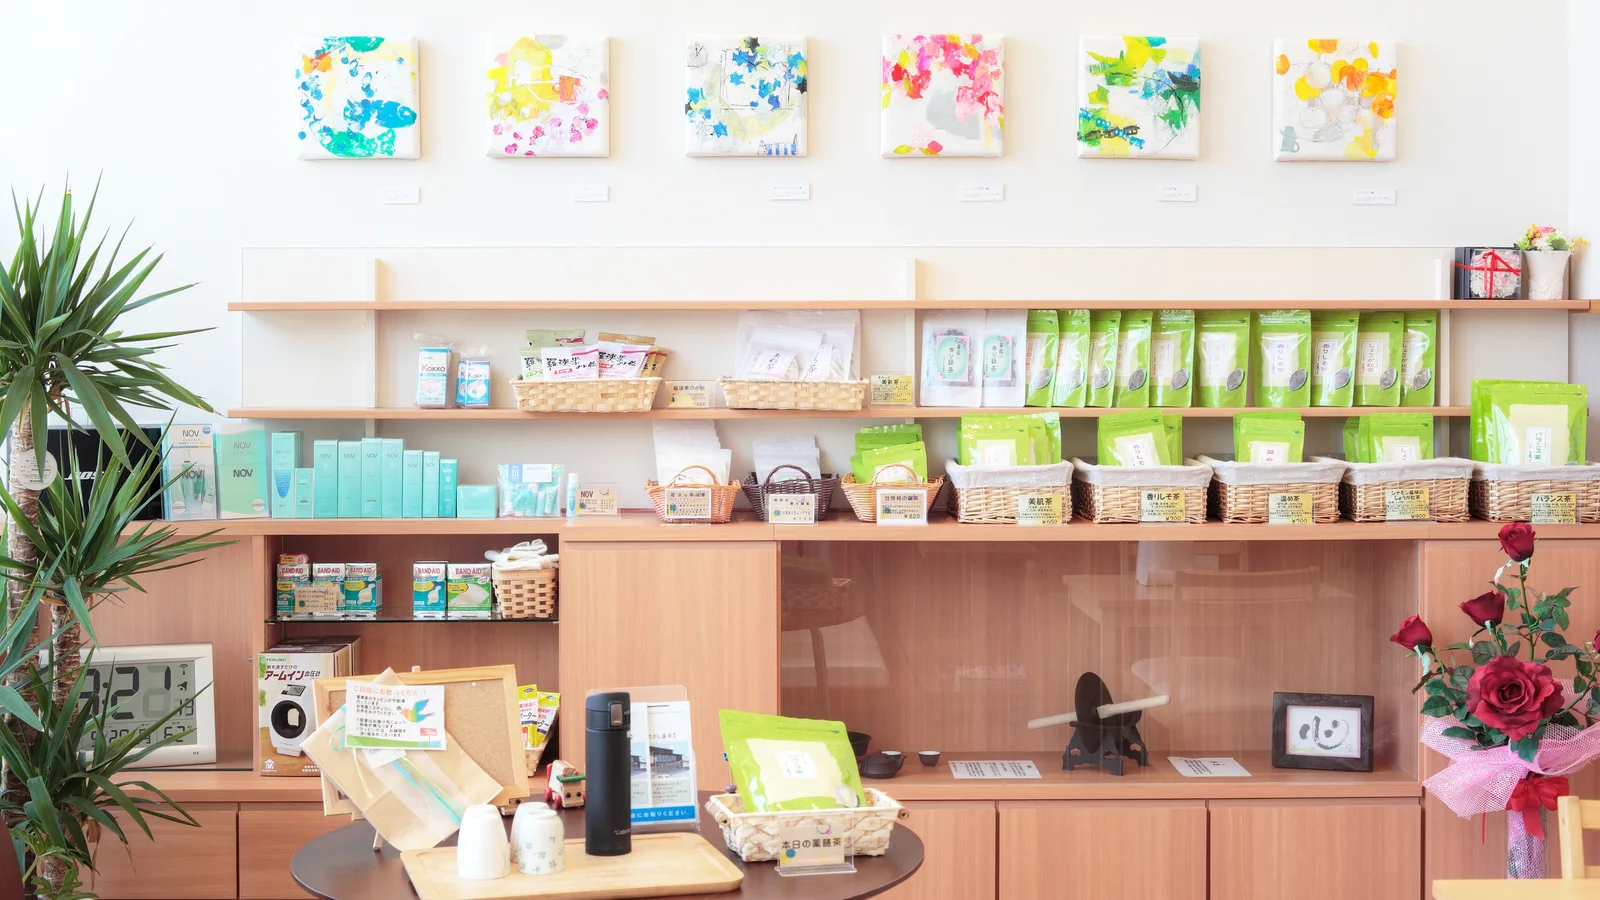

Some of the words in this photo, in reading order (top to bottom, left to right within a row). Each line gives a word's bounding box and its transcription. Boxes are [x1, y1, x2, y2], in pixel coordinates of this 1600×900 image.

[182, 429, 200, 438] NOV
[234, 441, 252, 450] NOV
[232, 468, 254, 478] NOV
[580, 490, 594, 498] NOV
[1146, 492, 1181, 501] 香りしそ茶
[1535, 494, 1572, 503] バランス茶
[1028, 497, 1053, 506] 美肌茶
[781, 836, 843, 850] 本日の薬膳茶
